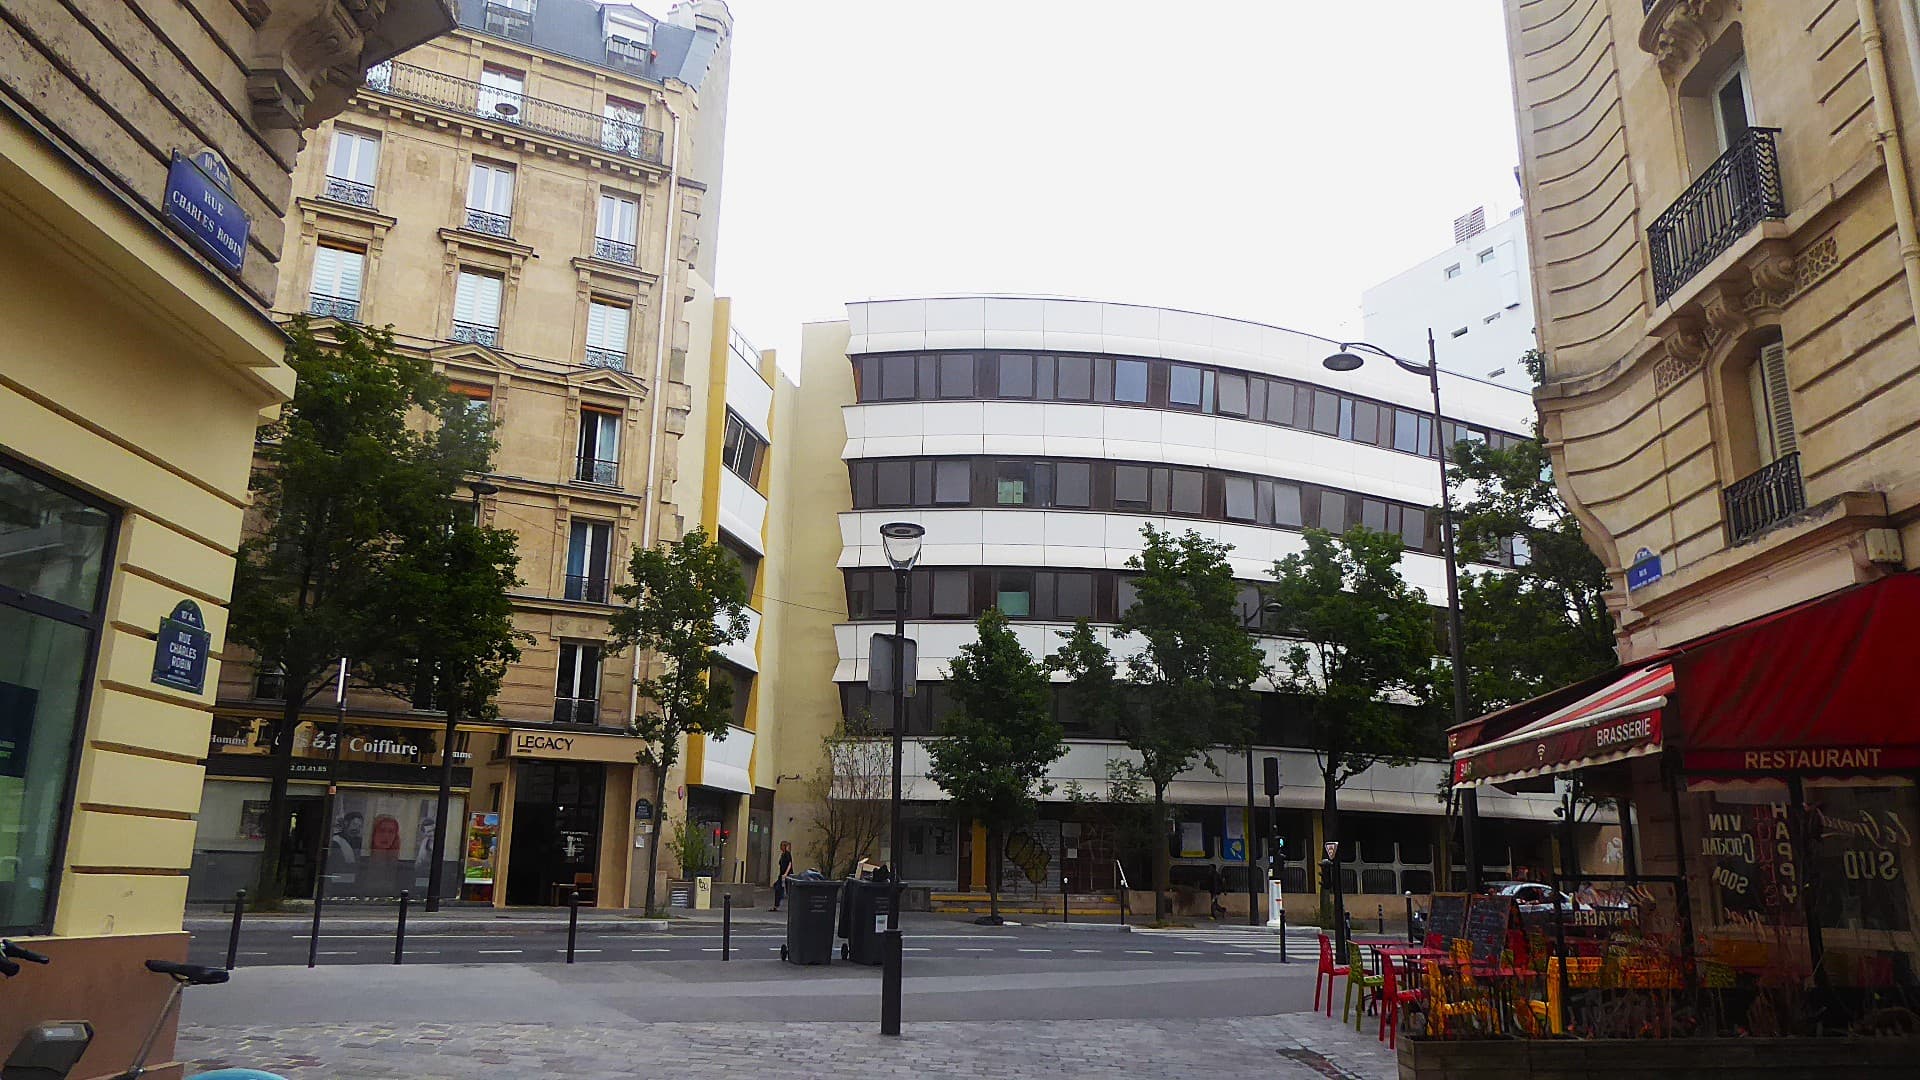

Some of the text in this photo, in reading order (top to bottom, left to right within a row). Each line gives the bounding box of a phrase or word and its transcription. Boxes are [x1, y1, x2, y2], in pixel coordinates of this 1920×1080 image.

[204, 190, 224, 216] RUE
[172, 190, 242, 258] CHARLES ROBIN
[178, 631, 193, 645] RUE
[169, 642, 197, 660] CHARLES
[171, 656, 192, 671] ROBIN
[1596, 717, 1651, 747] BRASSERIE
[350, 737, 418, 755] Coiffure
[517, 735, 574, 751] LEGACY
[1744, 748, 1882, 769] RESTAURANT
